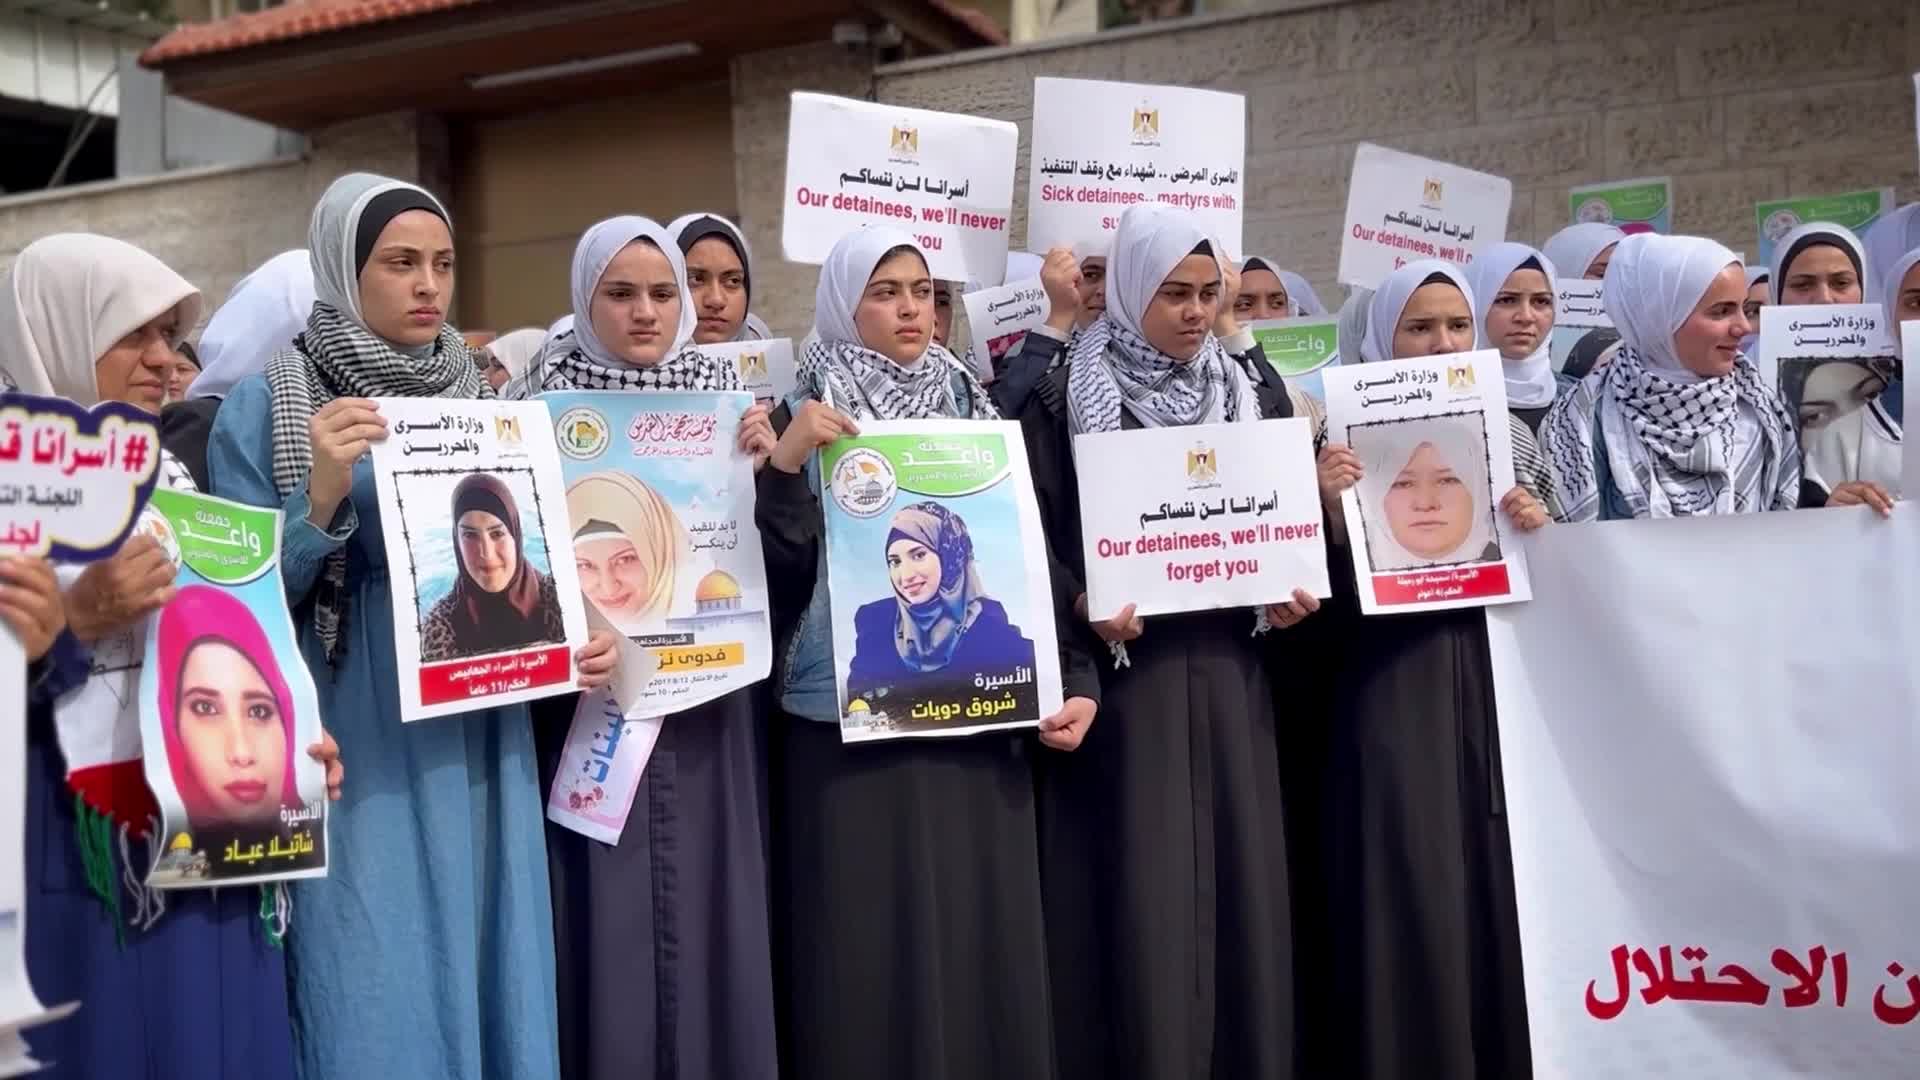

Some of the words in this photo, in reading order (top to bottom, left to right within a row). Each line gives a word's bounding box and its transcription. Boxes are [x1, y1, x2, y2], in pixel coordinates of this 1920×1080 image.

[840, 168, 892, 188] ننساكم
[1041, 157, 1078, 178] التنفيذ
[1080, 160, 1103, 180] وقف
[1106, 165, 1121, 181] مع
[1124, 161, 1155, 182] شهداء
[1170, 168, 1208, 183] المرضى
[896, 176, 920, 192] لن
[925, 177, 968, 199] أسرانا
[1042, 184, 1074, 202] Sick
[1157, 192, 1210, 210] martyrs
[1212, 194, 1236, 210] with
[797, 187, 829, 205] Our
[833, 193, 917, 222] detainees,
[922, 207, 956, 224] we'll
[961, 212, 1006, 231] never
[1383, 210, 1422, 227] ننساكم
[1423, 218, 1442, 232] لن
[1443, 222, 1475, 241] أسرانا
[1352, 223, 1375, 241] Our
[1377, 229, 1437, 258] detainees,
[1439, 245, 1465, 263] we'll
[1848, 316, 1875, 330] وزارة
[1794, 334, 1866, 348] والمحررين
[1411, 370, 1438, 384] وزارة
[1361, 388, 1432, 408] والمحررين
[458, 416, 484, 434] وزارة
[402, 438, 480, 456] والمحررين
[27, 485, 82, 512] اللجنة
[1230, 490, 1278, 517] أسرانا
[1140, 502, 1195, 529] ننساكم
[1200, 499, 1225, 521] لن
[180, 519, 261, 557] واعد
[1098, 538, 1131, 558] Our
[1135, 530, 1227, 555] detainees,
[1231, 523, 1270, 544] we'll
[1274, 522, 1320, 541] never
[1167, 559, 1221, 583] forget
[1225, 559, 1259, 581] you
[657, 651, 673, 670] نز
[678, 648, 726, 667] فدوى
[974, 665, 1032, 691] الأسيرة
[911, 701, 961, 720] دويات
[966, 692, 1016, 718] شروق
[280, 800, 321, 827] الأسيرة
[224, 837, 264, 864] عياد
[1585, 944, 1848, 1020] الاحتلال
